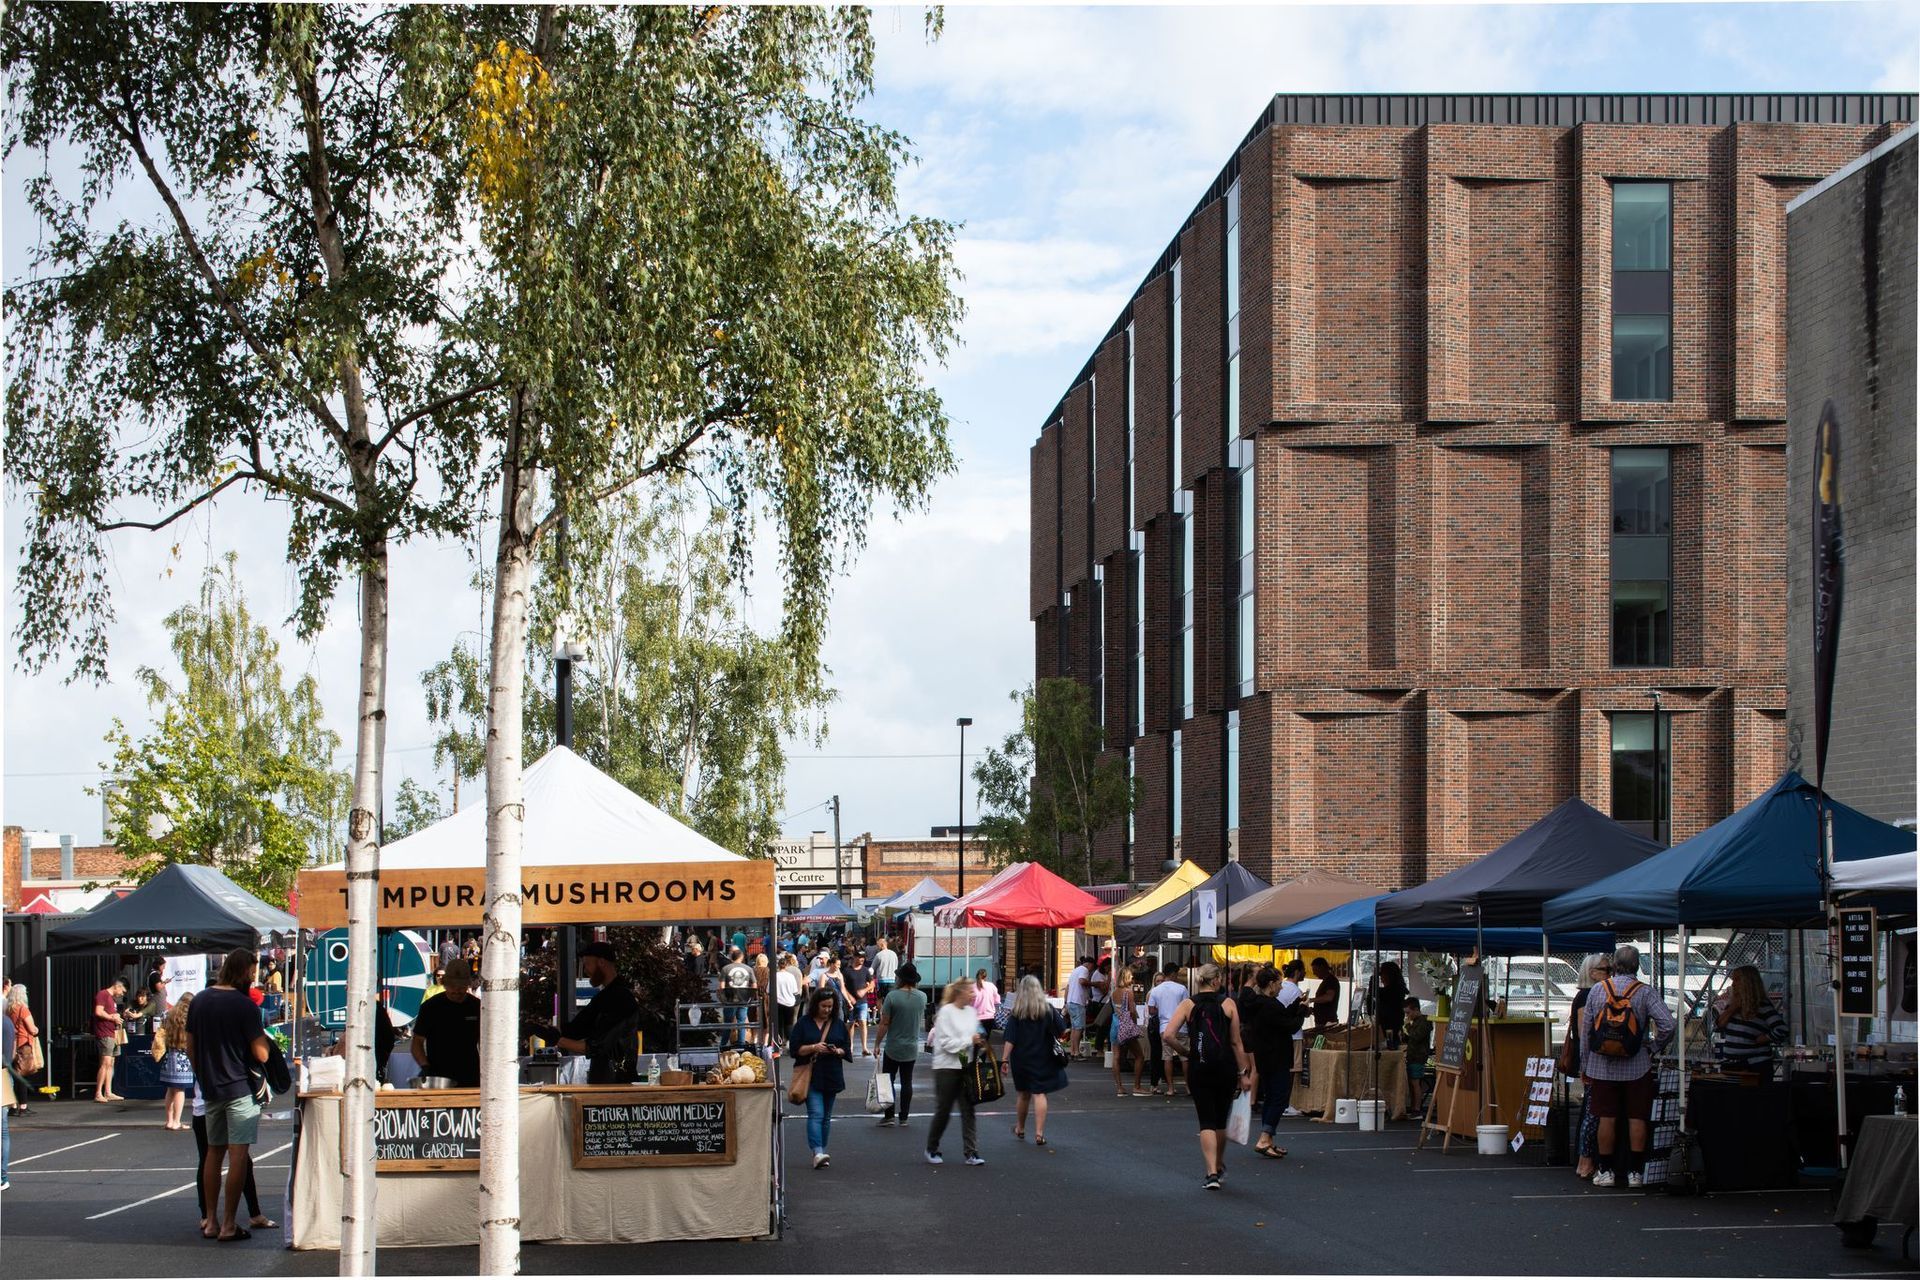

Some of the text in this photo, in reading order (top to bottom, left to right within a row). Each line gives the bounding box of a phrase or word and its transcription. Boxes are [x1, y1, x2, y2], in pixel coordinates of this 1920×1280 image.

[789, 872, 825, 882] Centre
[521, 879, 736, 905] MUSHROOMS
[114, 936, 188, 945] PROVENANCE
[584, 1103, 725, 1123] TEMPURA MUSHROOM MEDLEY
[374, 1109, 420, 1140] BROWN
[420, 1115, 430, 1129] &
[422, 1143, 464, 1159] GARDEN
